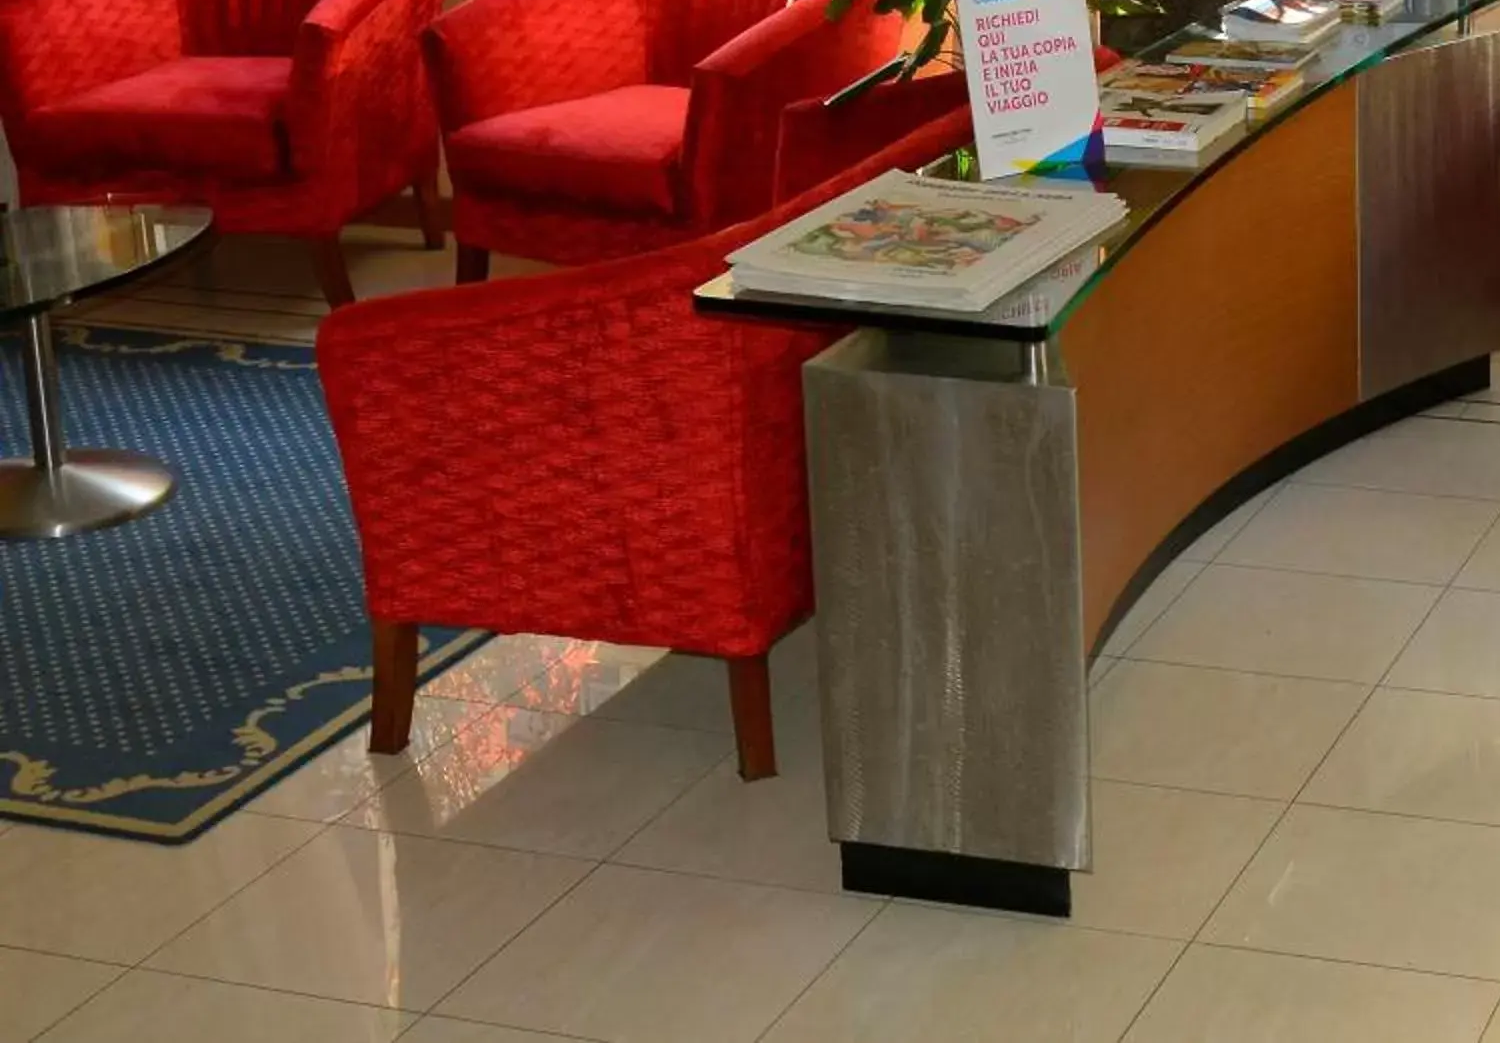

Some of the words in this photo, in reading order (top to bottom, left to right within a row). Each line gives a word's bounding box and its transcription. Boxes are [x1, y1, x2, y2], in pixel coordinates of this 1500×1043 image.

[976, 9, 1040, 31] RICHIEDI
[978, 32, 1005, 47] QUI
[981, 50, 998, 65] LA
[1001, 45, 1030, 60] TUA
[1033, 36, 1077, 55] COPIA
[983, 68, 992, 81] E
[995, 60, 1038, 79] INIZIA
[985, 84, 998, 98] IL
[1000, 78, 1031, 95] TUO
[987, 91, 1048, 114] VIAGGIO
